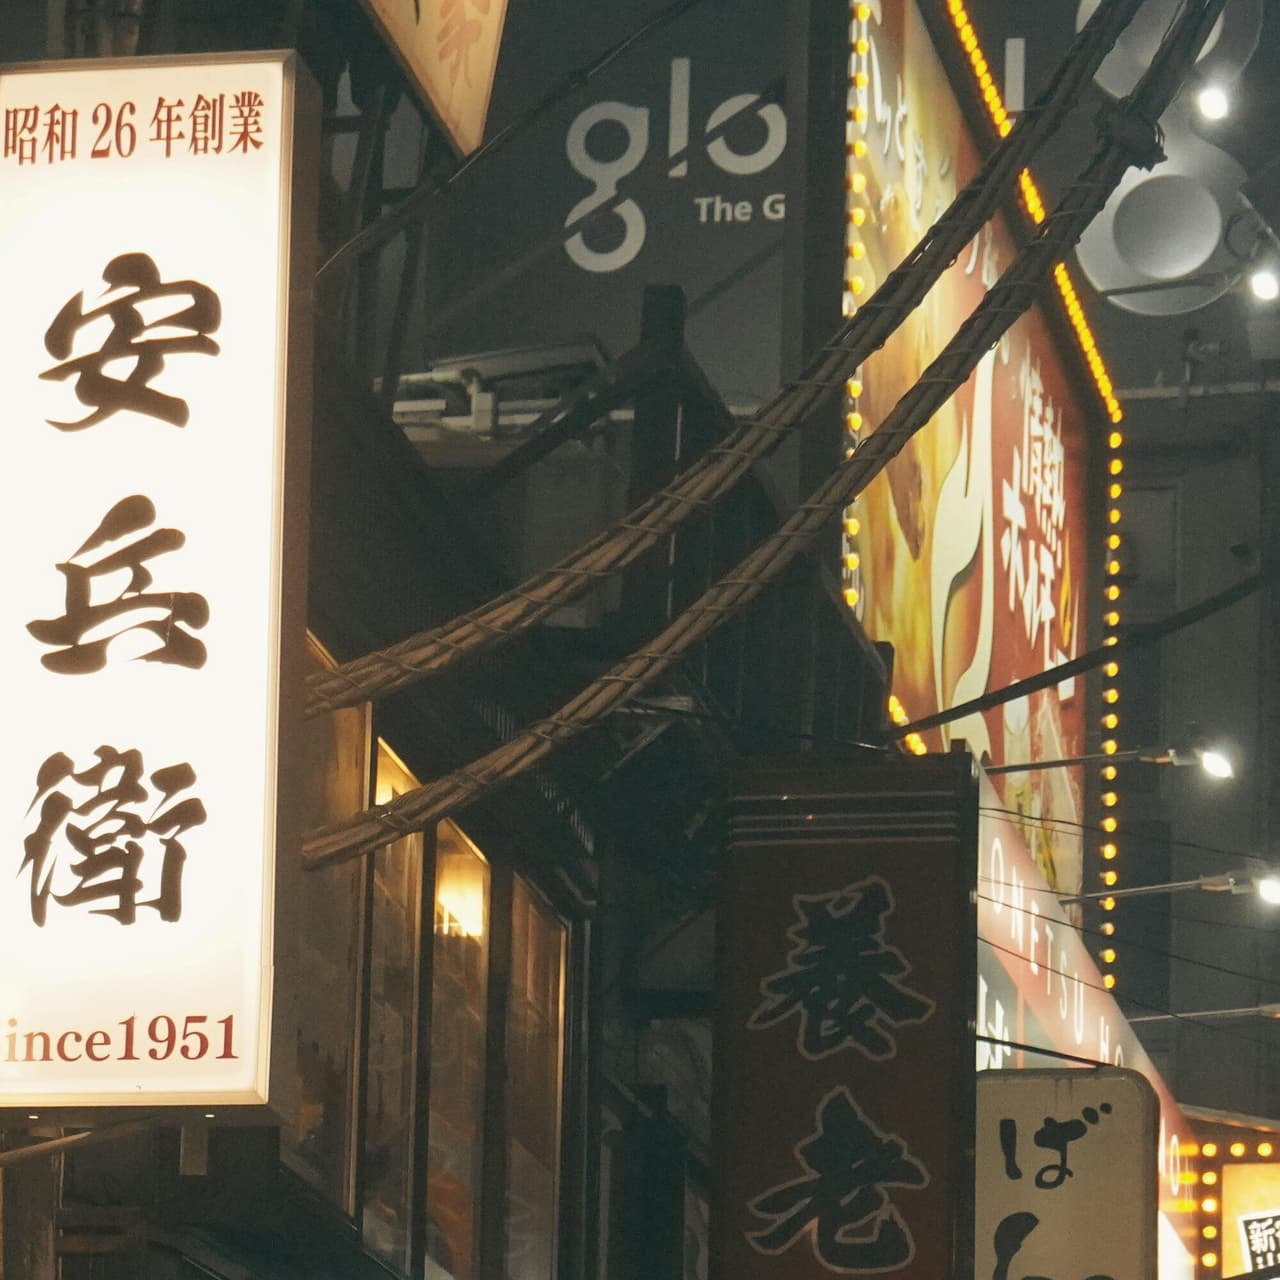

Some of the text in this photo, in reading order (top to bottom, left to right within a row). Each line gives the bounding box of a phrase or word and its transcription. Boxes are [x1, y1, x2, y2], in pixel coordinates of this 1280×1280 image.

[4, 91, 264, 166] 昭和26年創業
[564, 57, 787, 272] glo
[693, 195, 752, 223] The
[16, 252, 222, 927] 安兵衛
